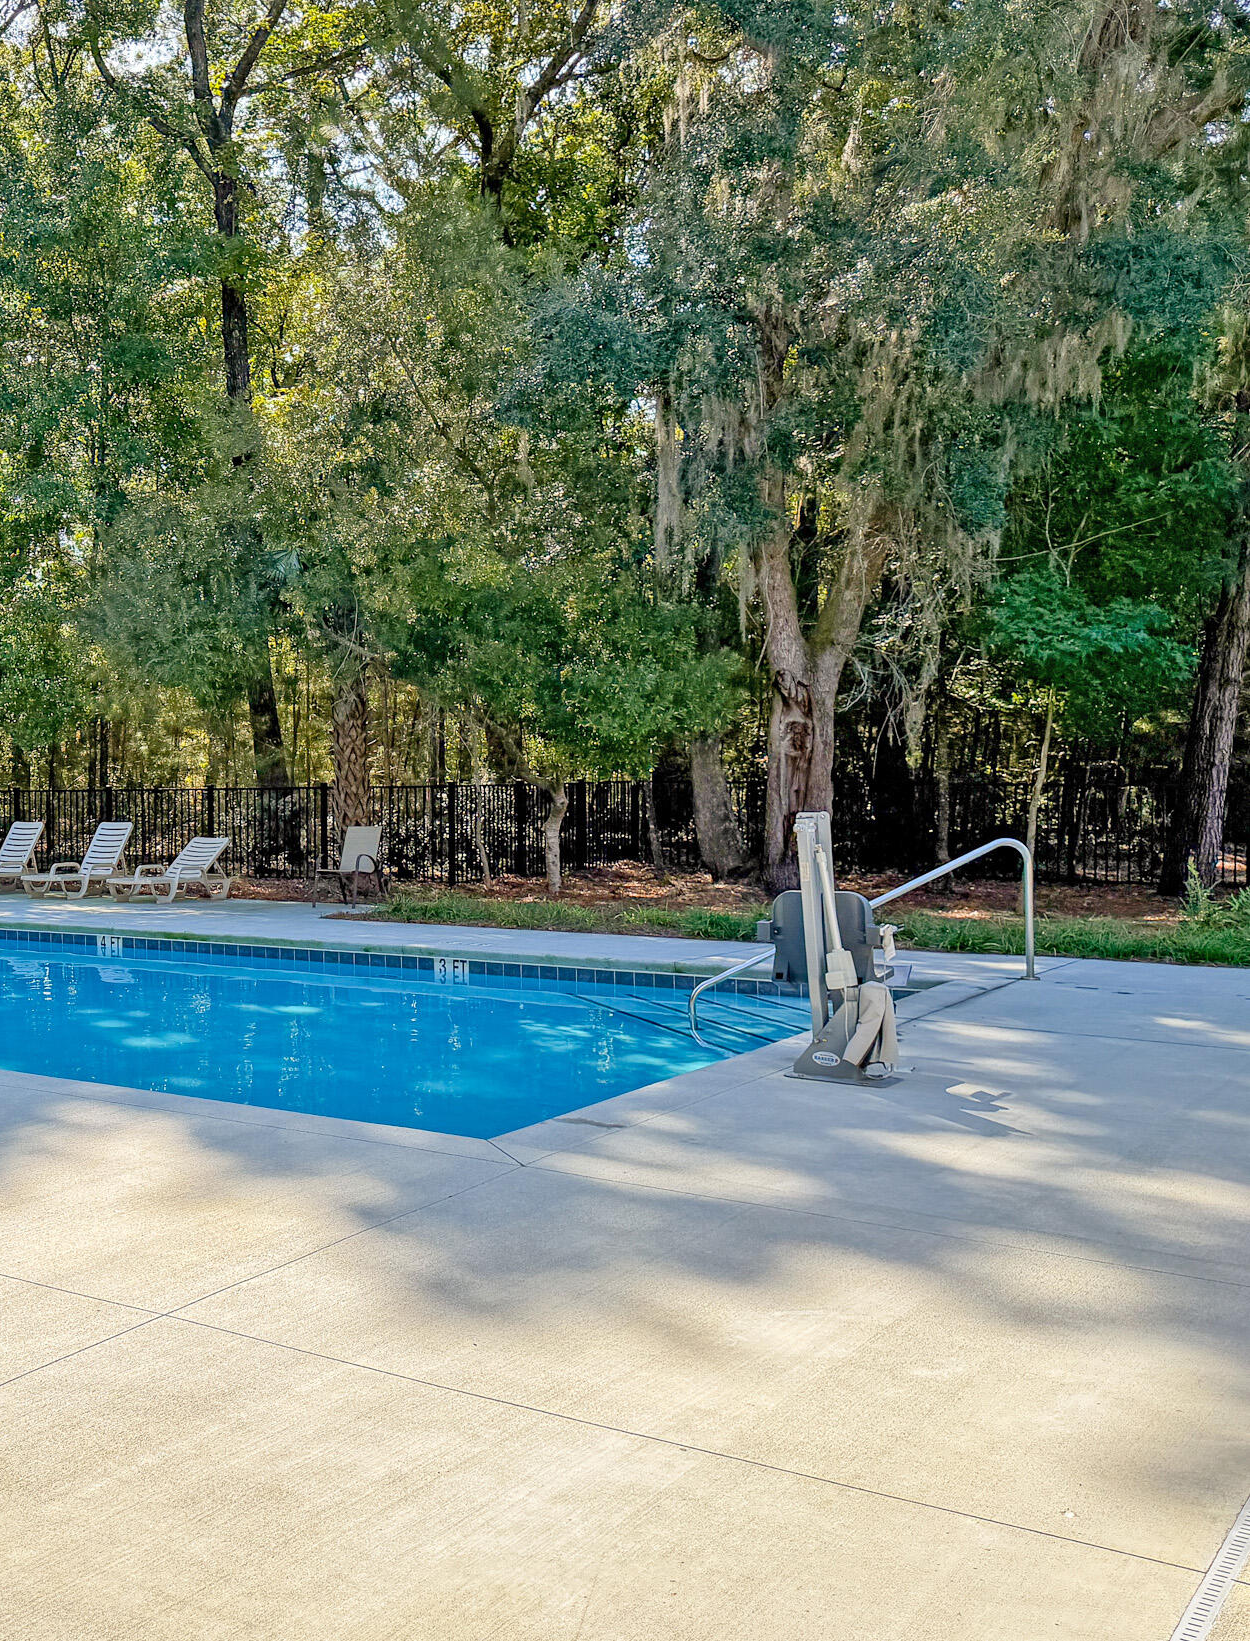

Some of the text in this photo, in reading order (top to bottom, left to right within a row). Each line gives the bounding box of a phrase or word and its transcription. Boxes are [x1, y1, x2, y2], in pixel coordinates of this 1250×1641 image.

[100, 935, 107, 947] 4
[439, 958, 468, 973] 3 FT
